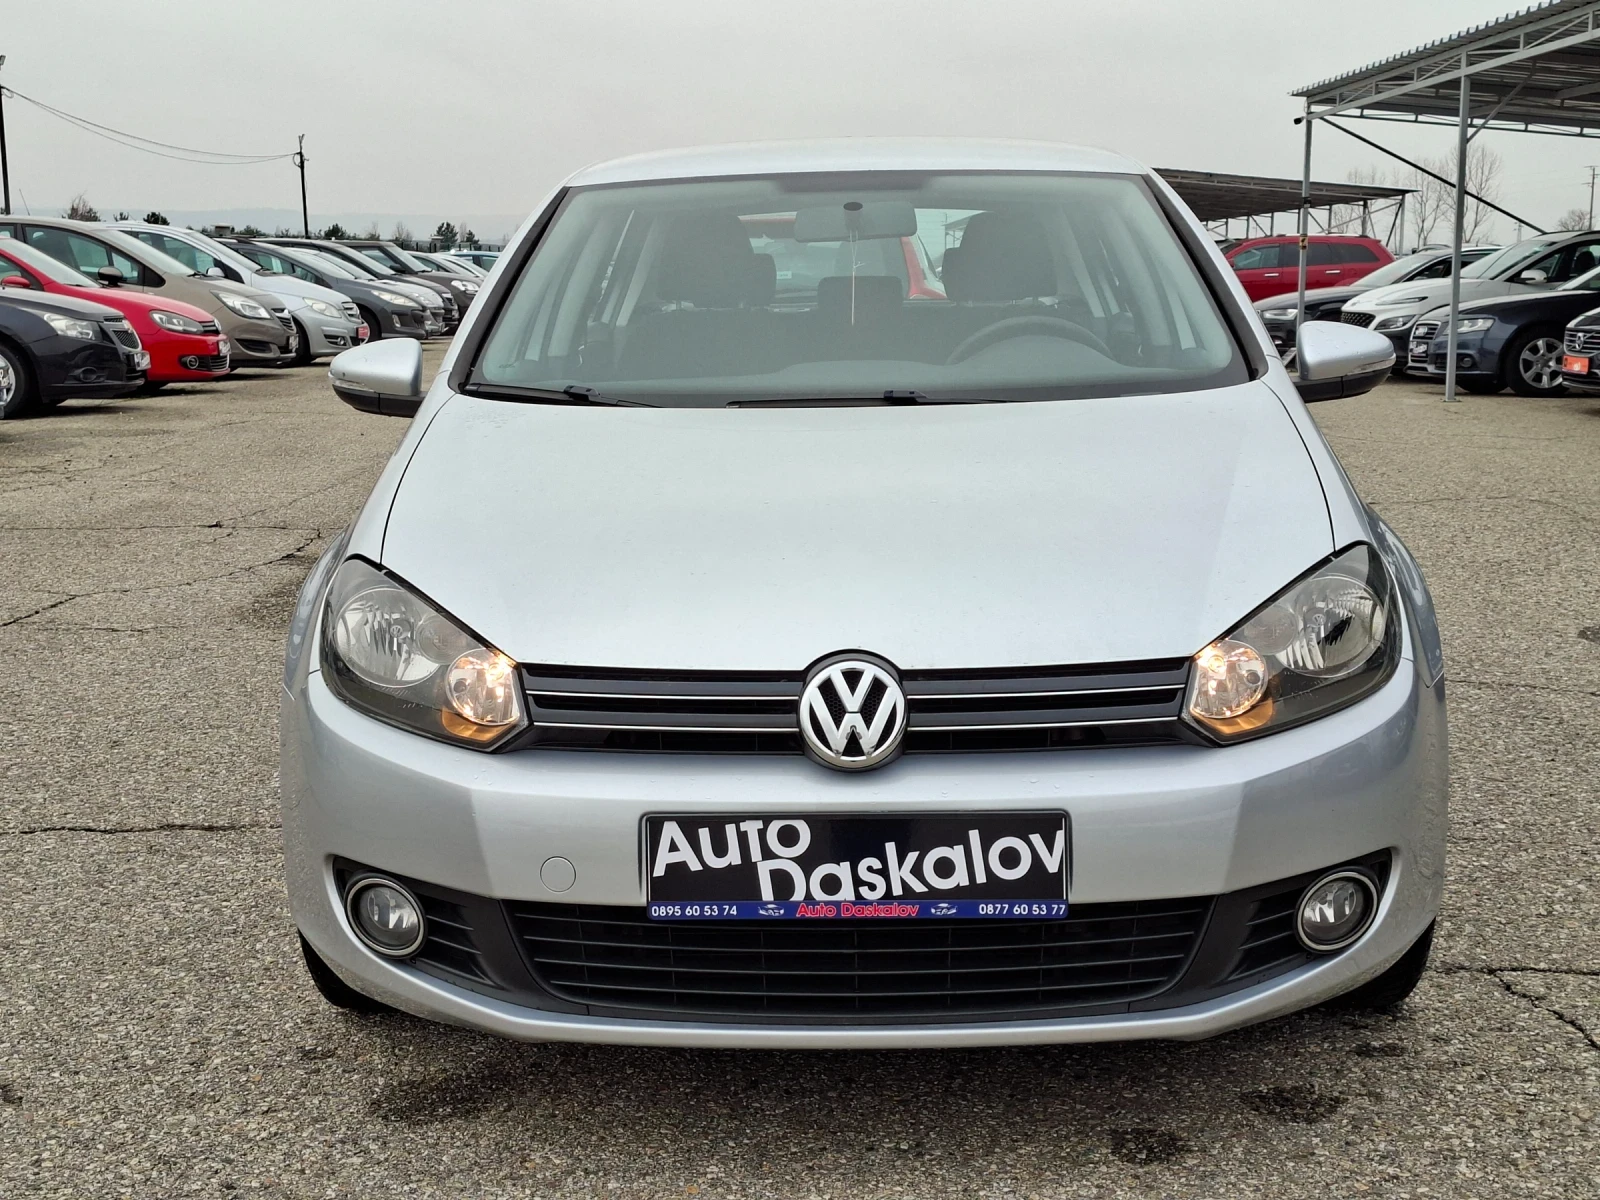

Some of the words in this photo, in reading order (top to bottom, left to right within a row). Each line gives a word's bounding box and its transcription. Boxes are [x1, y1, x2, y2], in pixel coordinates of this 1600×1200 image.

[803, 662, 903, 766] VW
[653, 819, 811, 877] Auto
[757, 829, 1064, 902] Daskalov
[651, 905, 682, 917] 0895
[685, 905, 701, 916] 60
[703, 905, 719, 915] 53
[722, 905, 738, 915] 74
[796, 903, 837, 917] Auto
[841, 902, 919, 917] Daskalov
[978, 904, 1009, 915] 0877
[1013, 904, 1029, 915] 60
[1032, 904, 1047, 915] 53
[1051, 904, 1066, 914] 77
